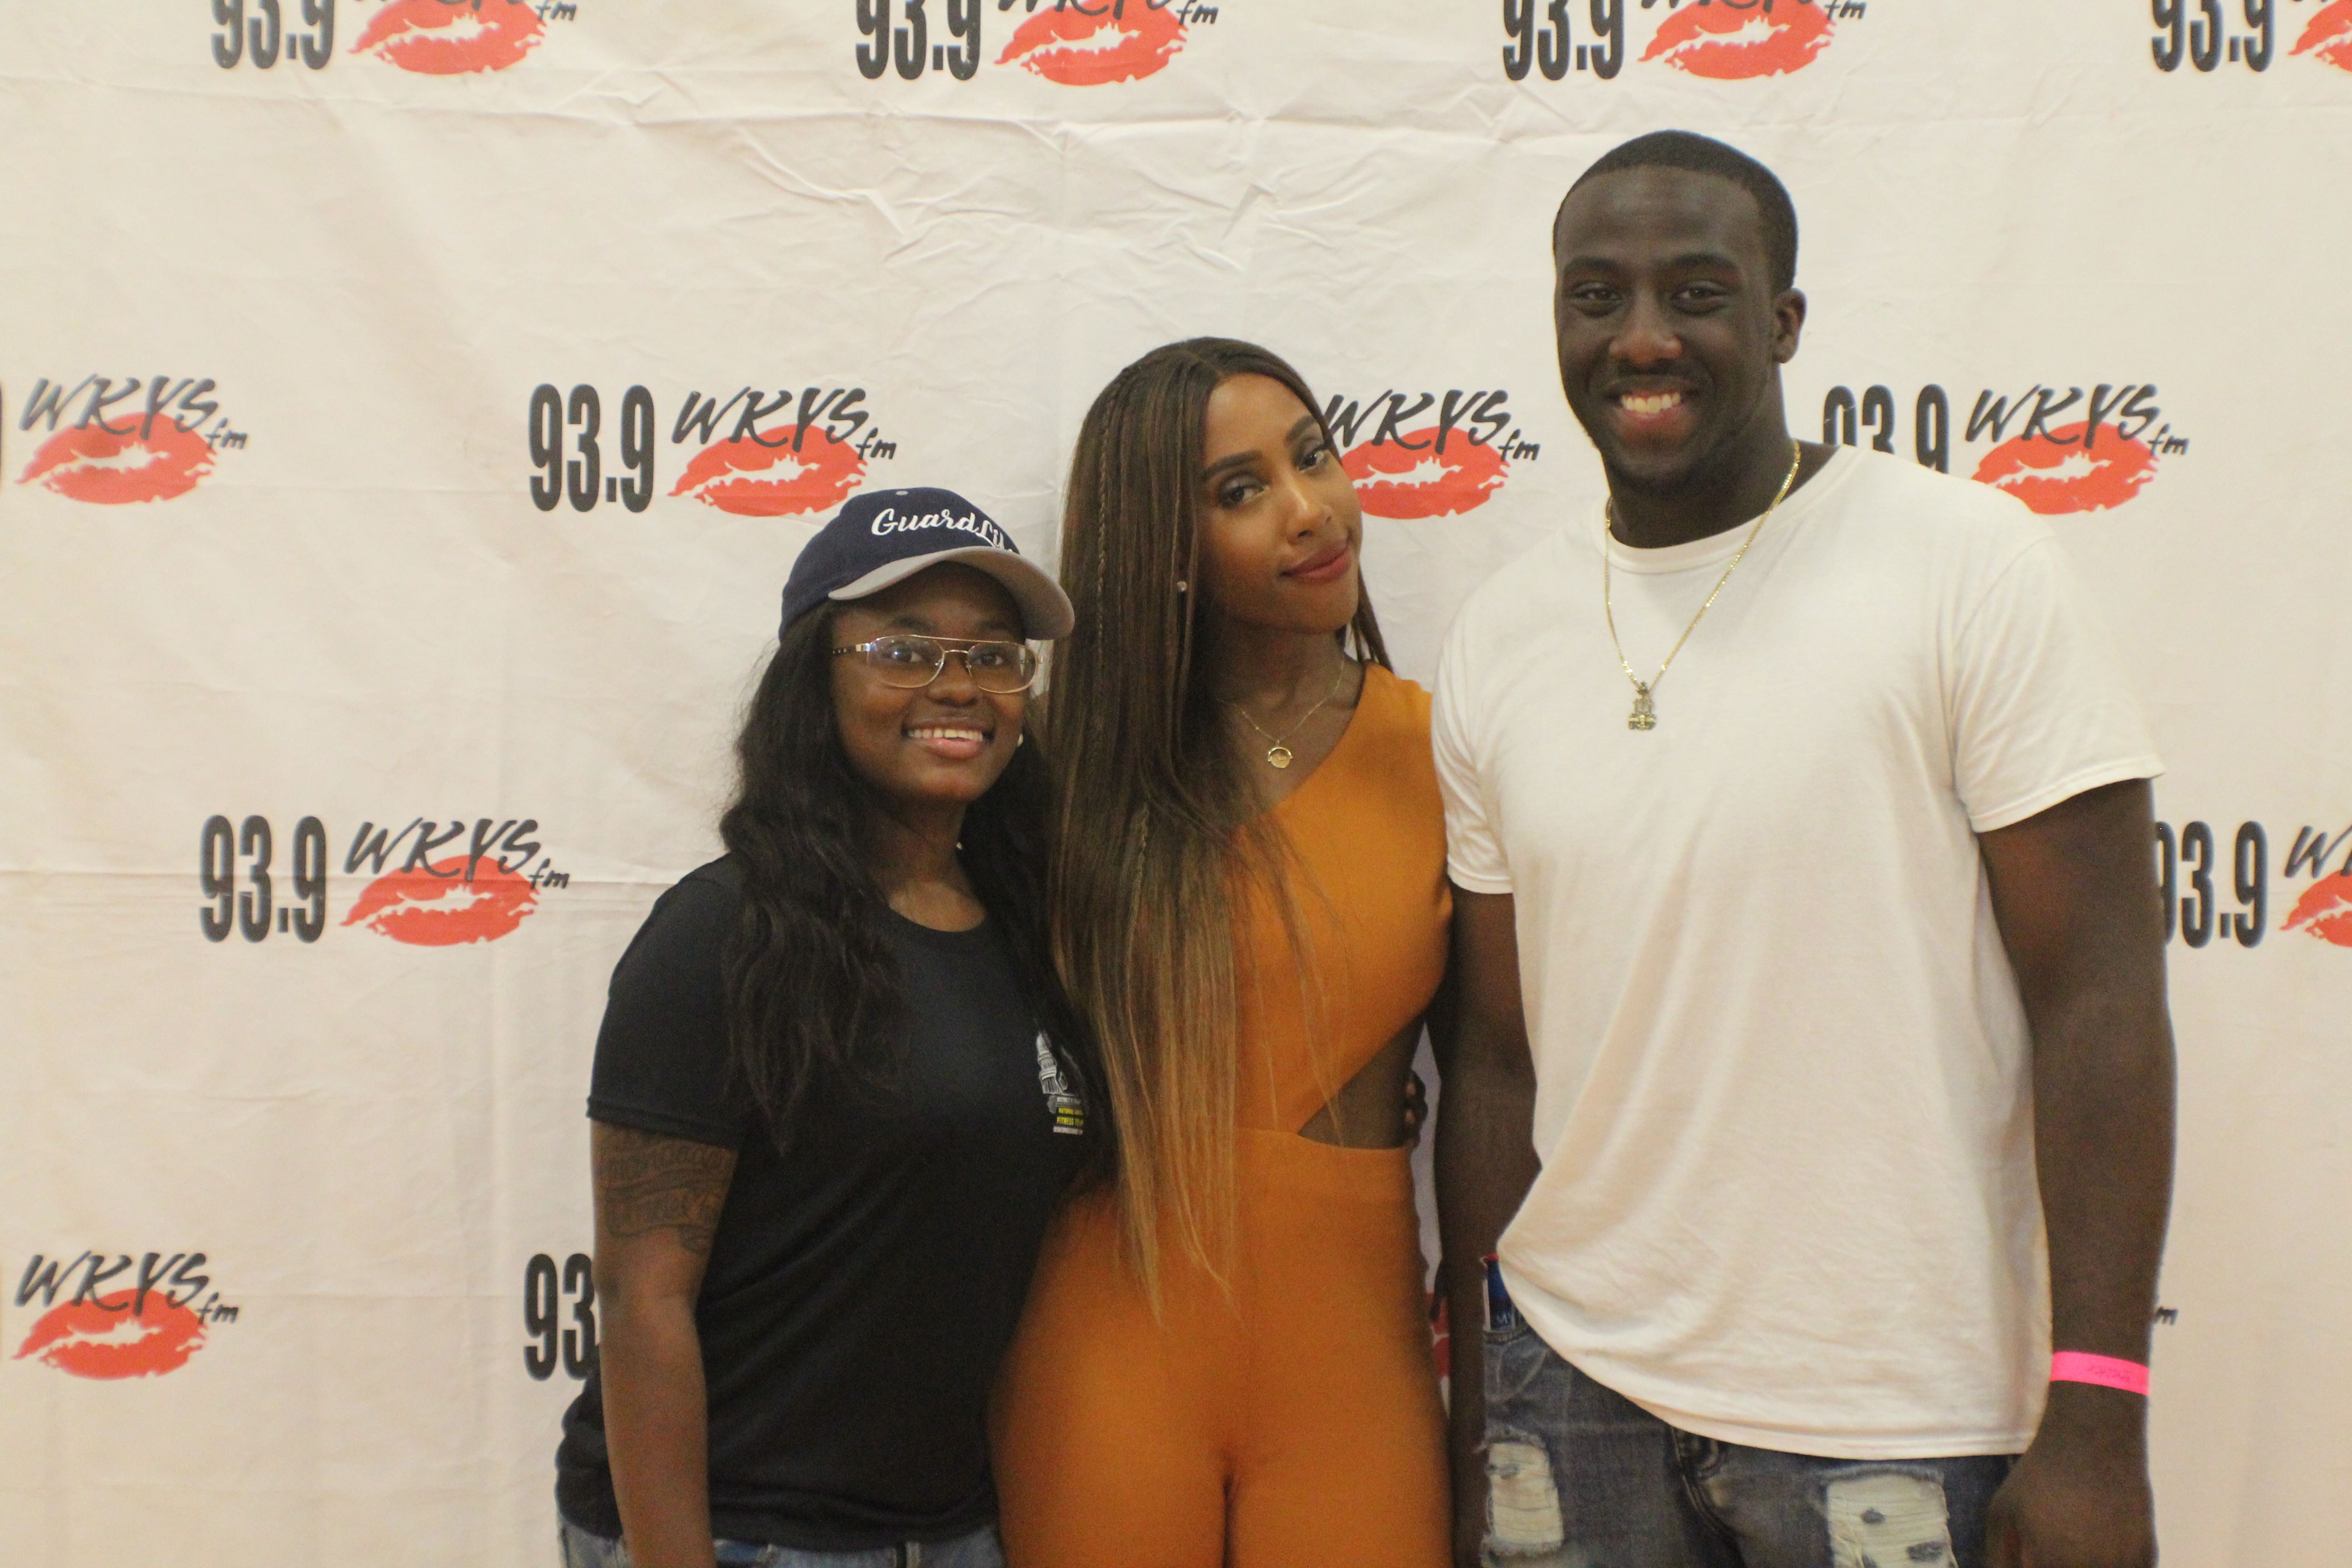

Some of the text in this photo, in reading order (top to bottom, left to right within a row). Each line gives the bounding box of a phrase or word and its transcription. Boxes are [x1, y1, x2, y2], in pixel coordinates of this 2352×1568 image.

[1176, 0, 1219, 25] fm
[18, 374, 219, 440] WKYS
[205, 417, 248, 449] fm
[529, 384, 897, 512] 93.9 WKYS fm
[1323, 389, 1540, 461] WKYS fm
[1966, 384, 2161, 448] WKYS
[2147, 423, 2189, 456] fm
[200, 815, 570, 943] 93.9 WKYS fm
[14, 1251, 239, 1324] WKYS fm
